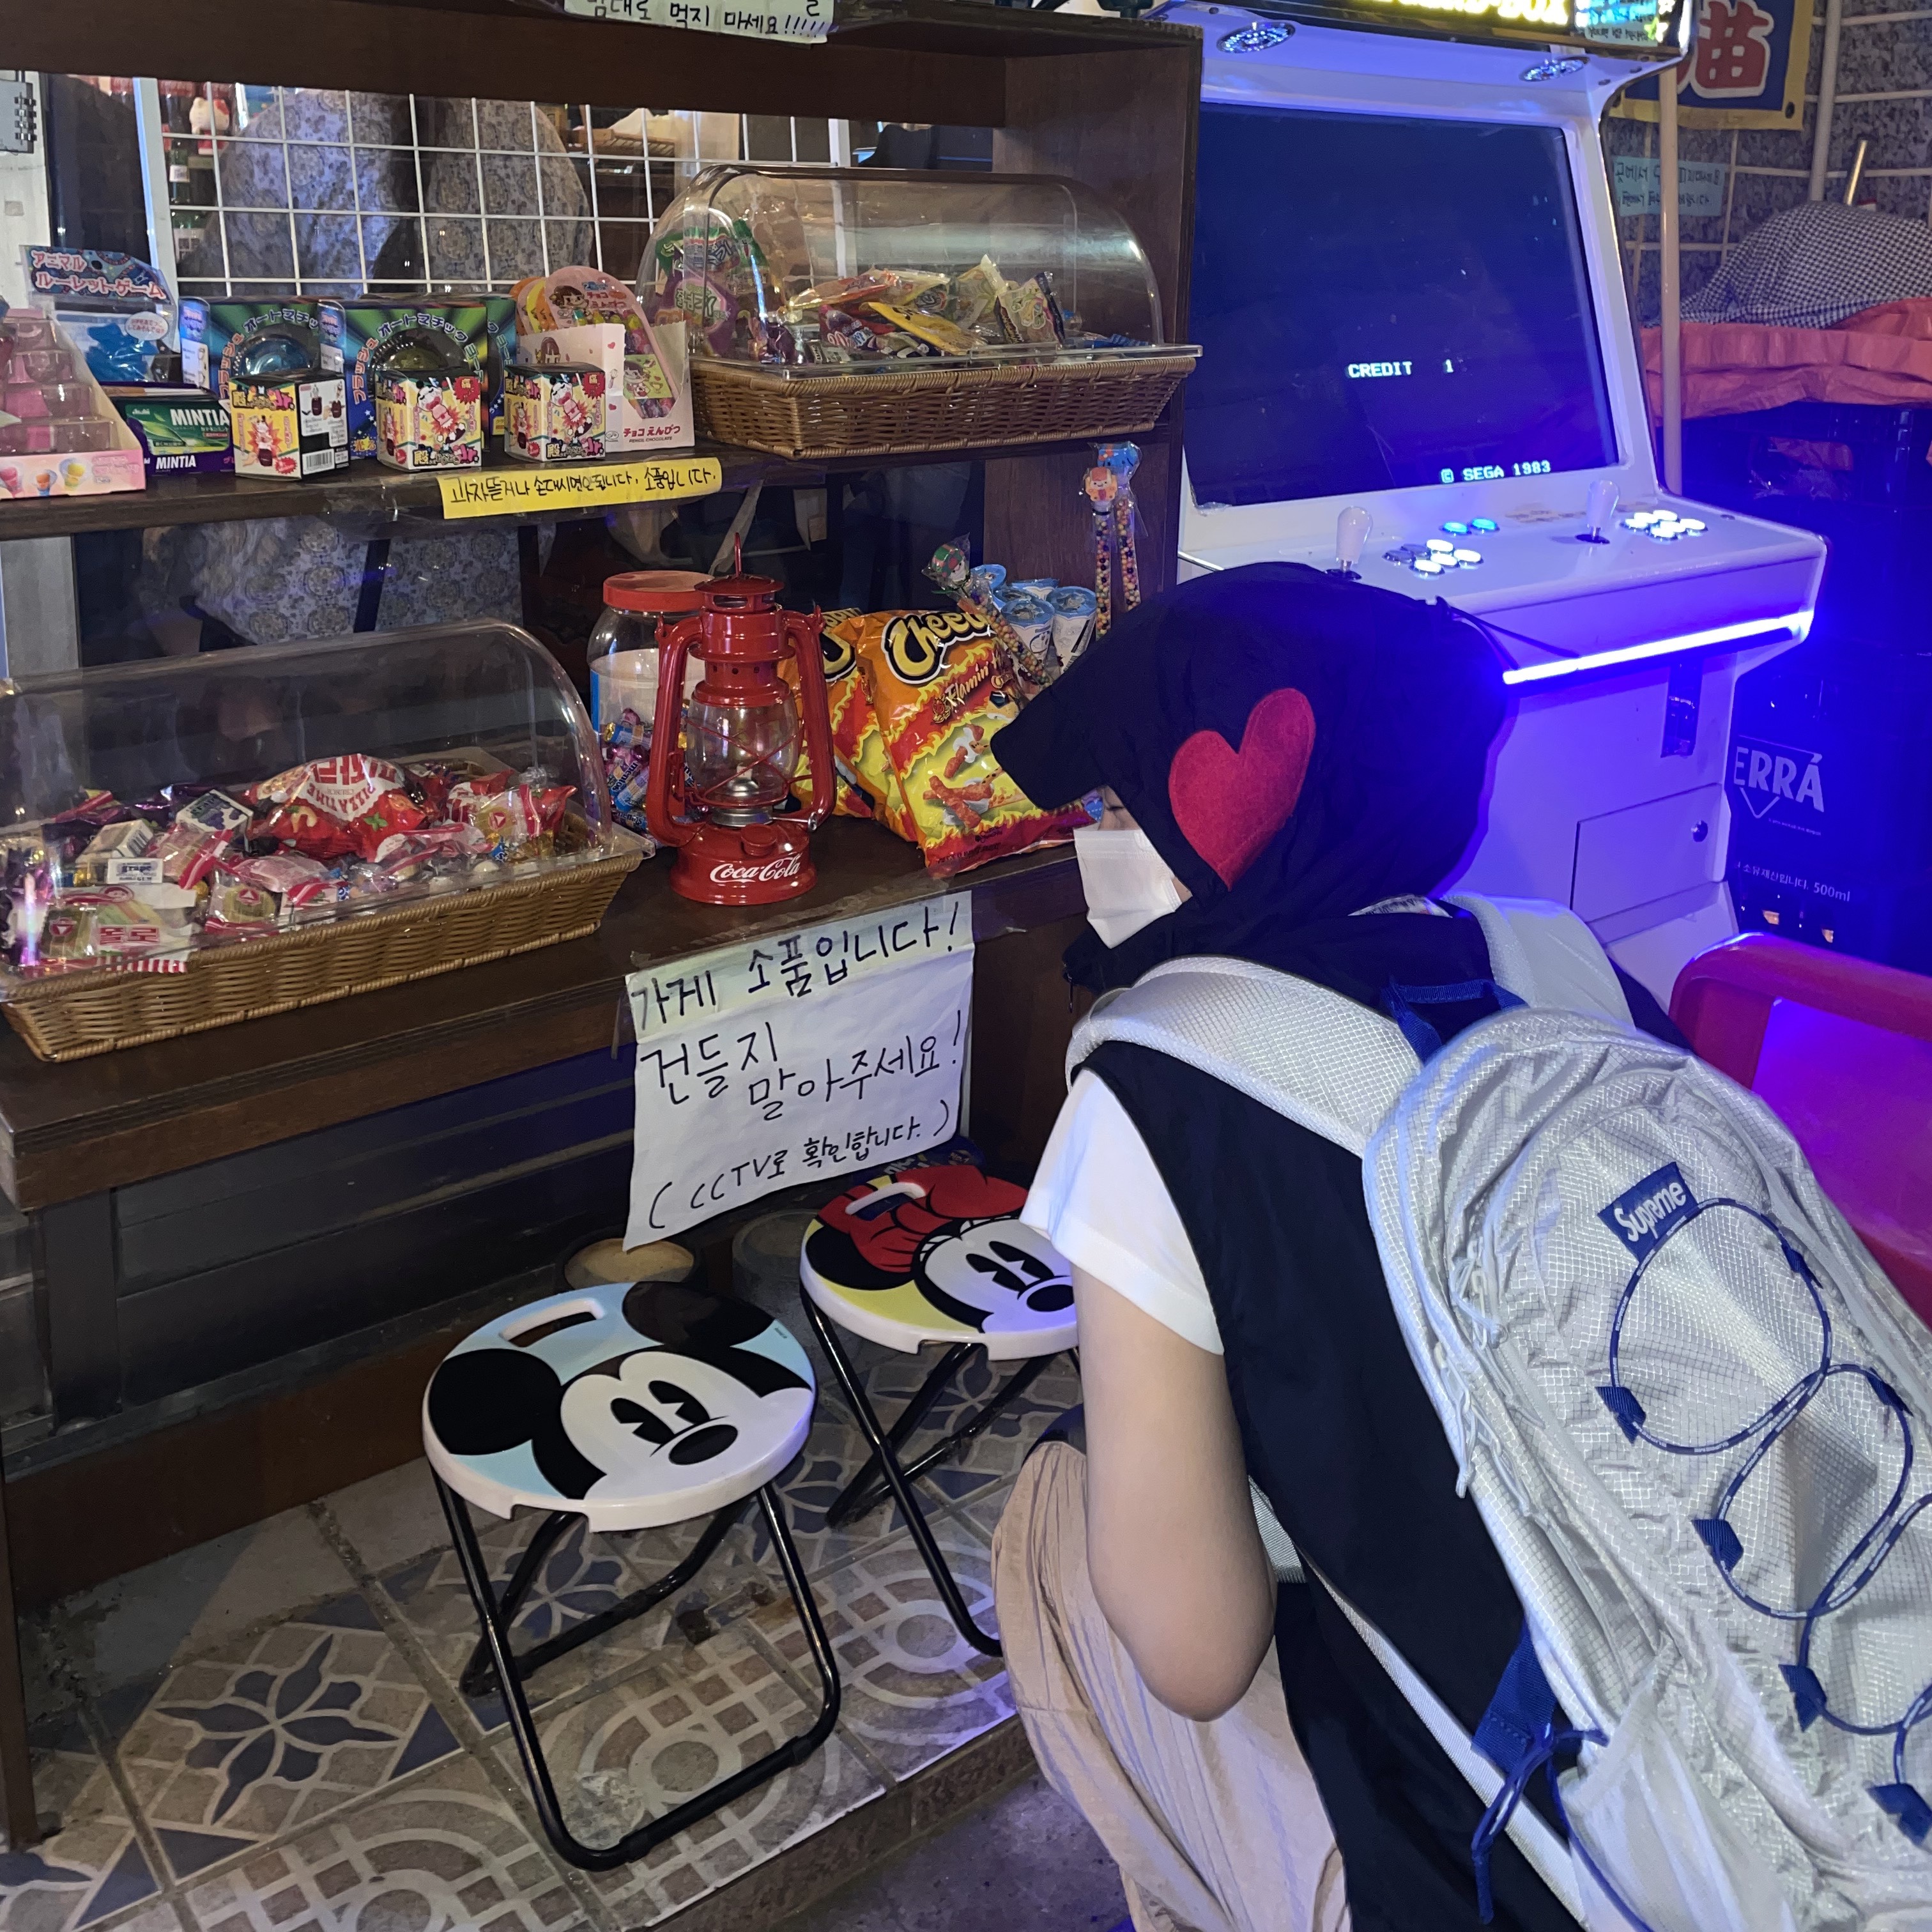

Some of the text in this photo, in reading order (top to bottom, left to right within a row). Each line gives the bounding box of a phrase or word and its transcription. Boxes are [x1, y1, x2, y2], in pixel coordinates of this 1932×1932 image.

[670, 3, 709, 29] 먹지
[31, 250, 88, 272] アニマル
[36, 272, 167, 300] ルーレットゲーム
[243, 308, 319, 333] オートマチッ
[352, 337, 379, 405] フラッシュ
[377, 312, 468, 342] オートマチック
[1347, 358, 1454, 378] CREDIT 1
[170, 409, 229, 426] MINTIA
[624, 425, 680, 438] チョコ えんぴつ
[156, 455, 196, 470] MINTIA
[1462, 465, 1505, 481] SEGA
[1513, 460, 1551, 476] 1983
[644, 467, 716, 491] 소품입니다.
[611, 762, 638, 792] mentos
[307, 782, 337, 812] TIME
[710, 852, 802, 883] Coca-Cola
[1814, 882, 1850, 901] 500ml
[631, 901, 960, 1031] 가게 소품입니다!
[640, 1022, 778, 1105] 건들지
[748, 1009, 962, 1121] 말아주세요!
[1614, 1182, 1686, 1242] Supreme
